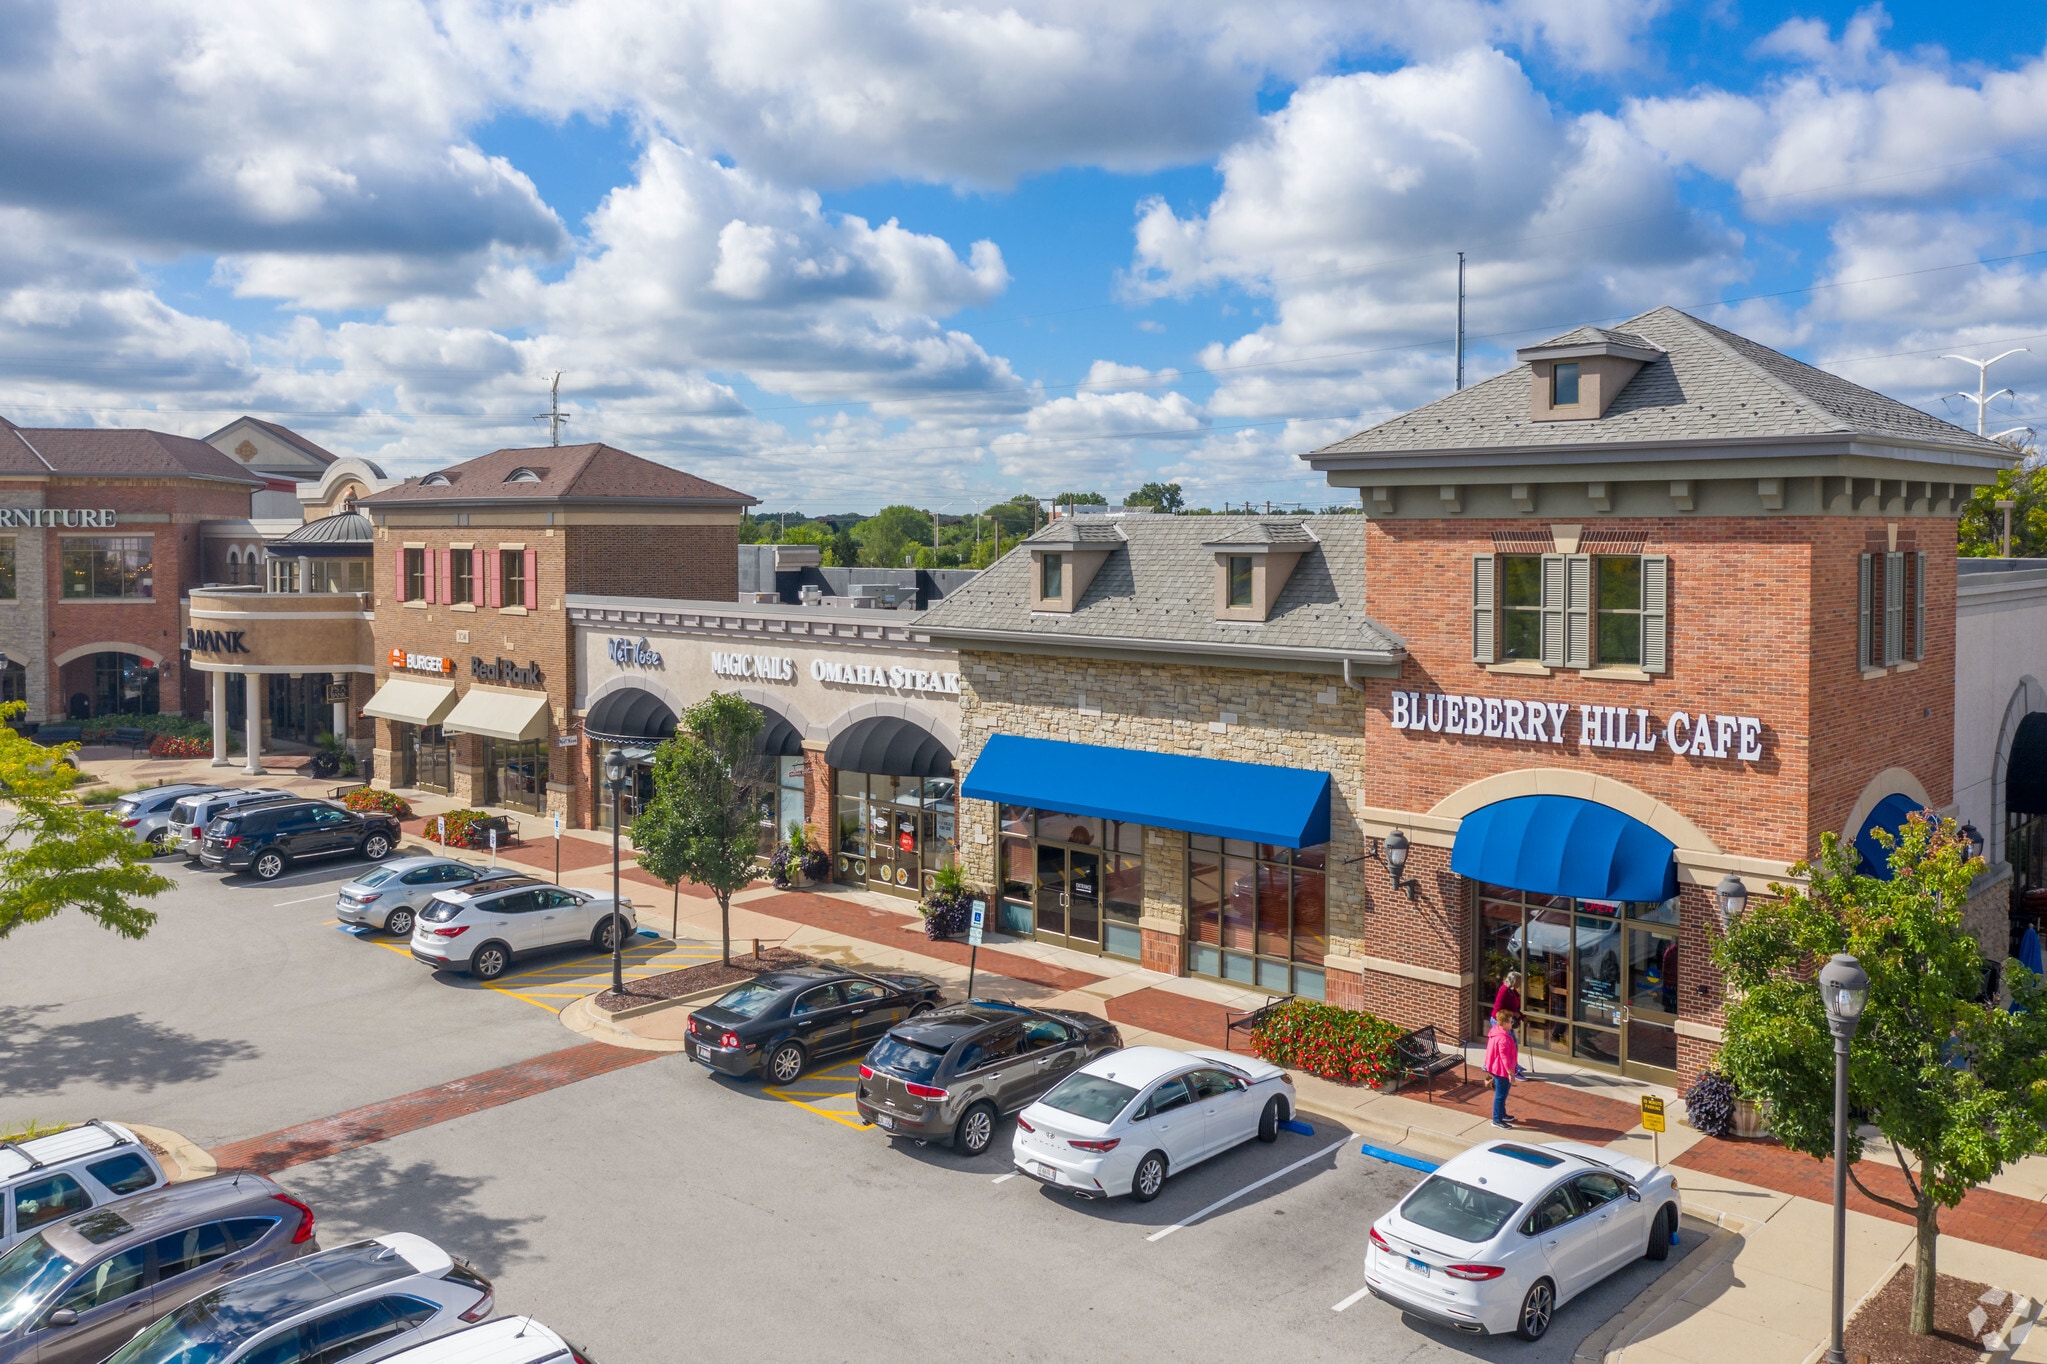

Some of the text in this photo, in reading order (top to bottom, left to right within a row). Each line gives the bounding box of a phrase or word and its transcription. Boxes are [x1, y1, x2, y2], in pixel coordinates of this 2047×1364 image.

[0, 508, 117, 528] RNITURE
[196, 629, 250, 653] BANK
[607, 637, 660, 667] Wet Nose
[471, 656, 541, 684] Beal Bank
[711, 652, 794, 681] MAGIC NAILS
[811, 659, 888, 687] OMAHA
[1391, 691, 1763, 762] BLUEBERRY HILL CAFE
[1585, 900, 1614, 913] OPEN
[1644, 1103, 1661, 1111] PARKING
